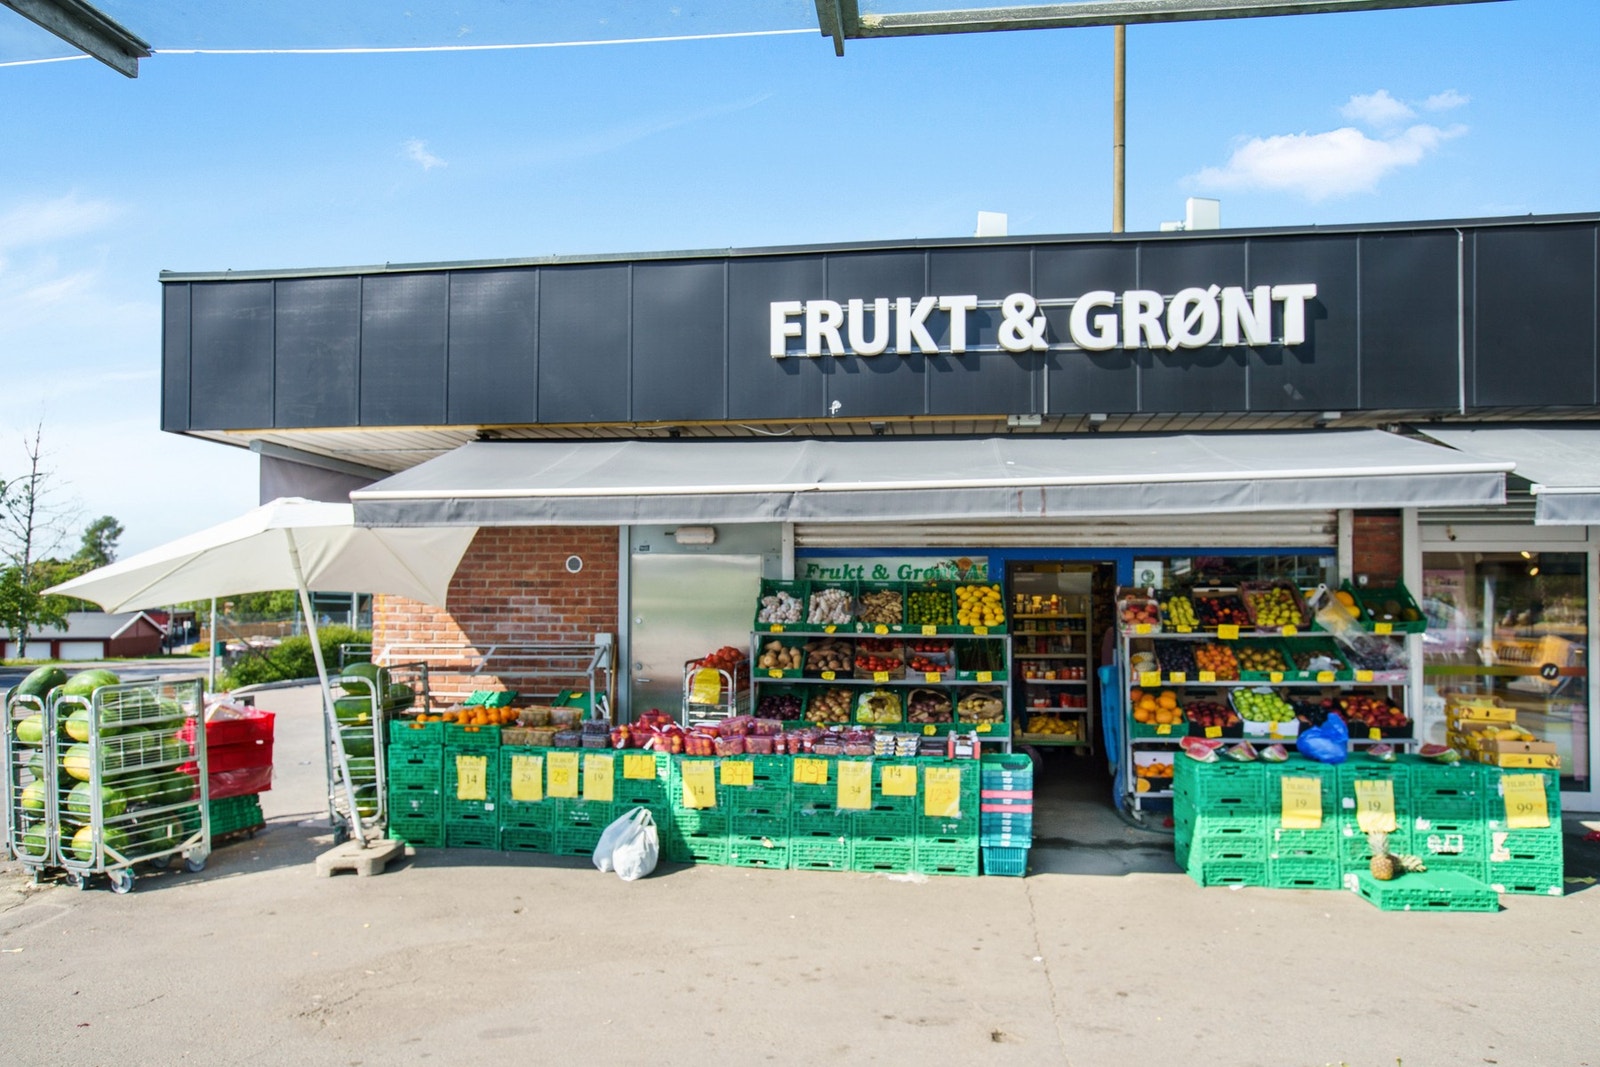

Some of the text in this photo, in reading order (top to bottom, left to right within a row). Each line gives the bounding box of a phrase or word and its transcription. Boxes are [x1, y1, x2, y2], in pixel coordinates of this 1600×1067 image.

[770, 283, 1317, 359] FRUKT & GRØNT
[805, 563, 865, 580] Frukt
[872, 563, 890, 580] &
[466, 774, 478, 785] 14
[693, 785, 705, 796] 14
[1295, 798, 1308, 809] 19
[1368, 800, 1382, 812] 19
[1516, 802, 1534, 815] 99
